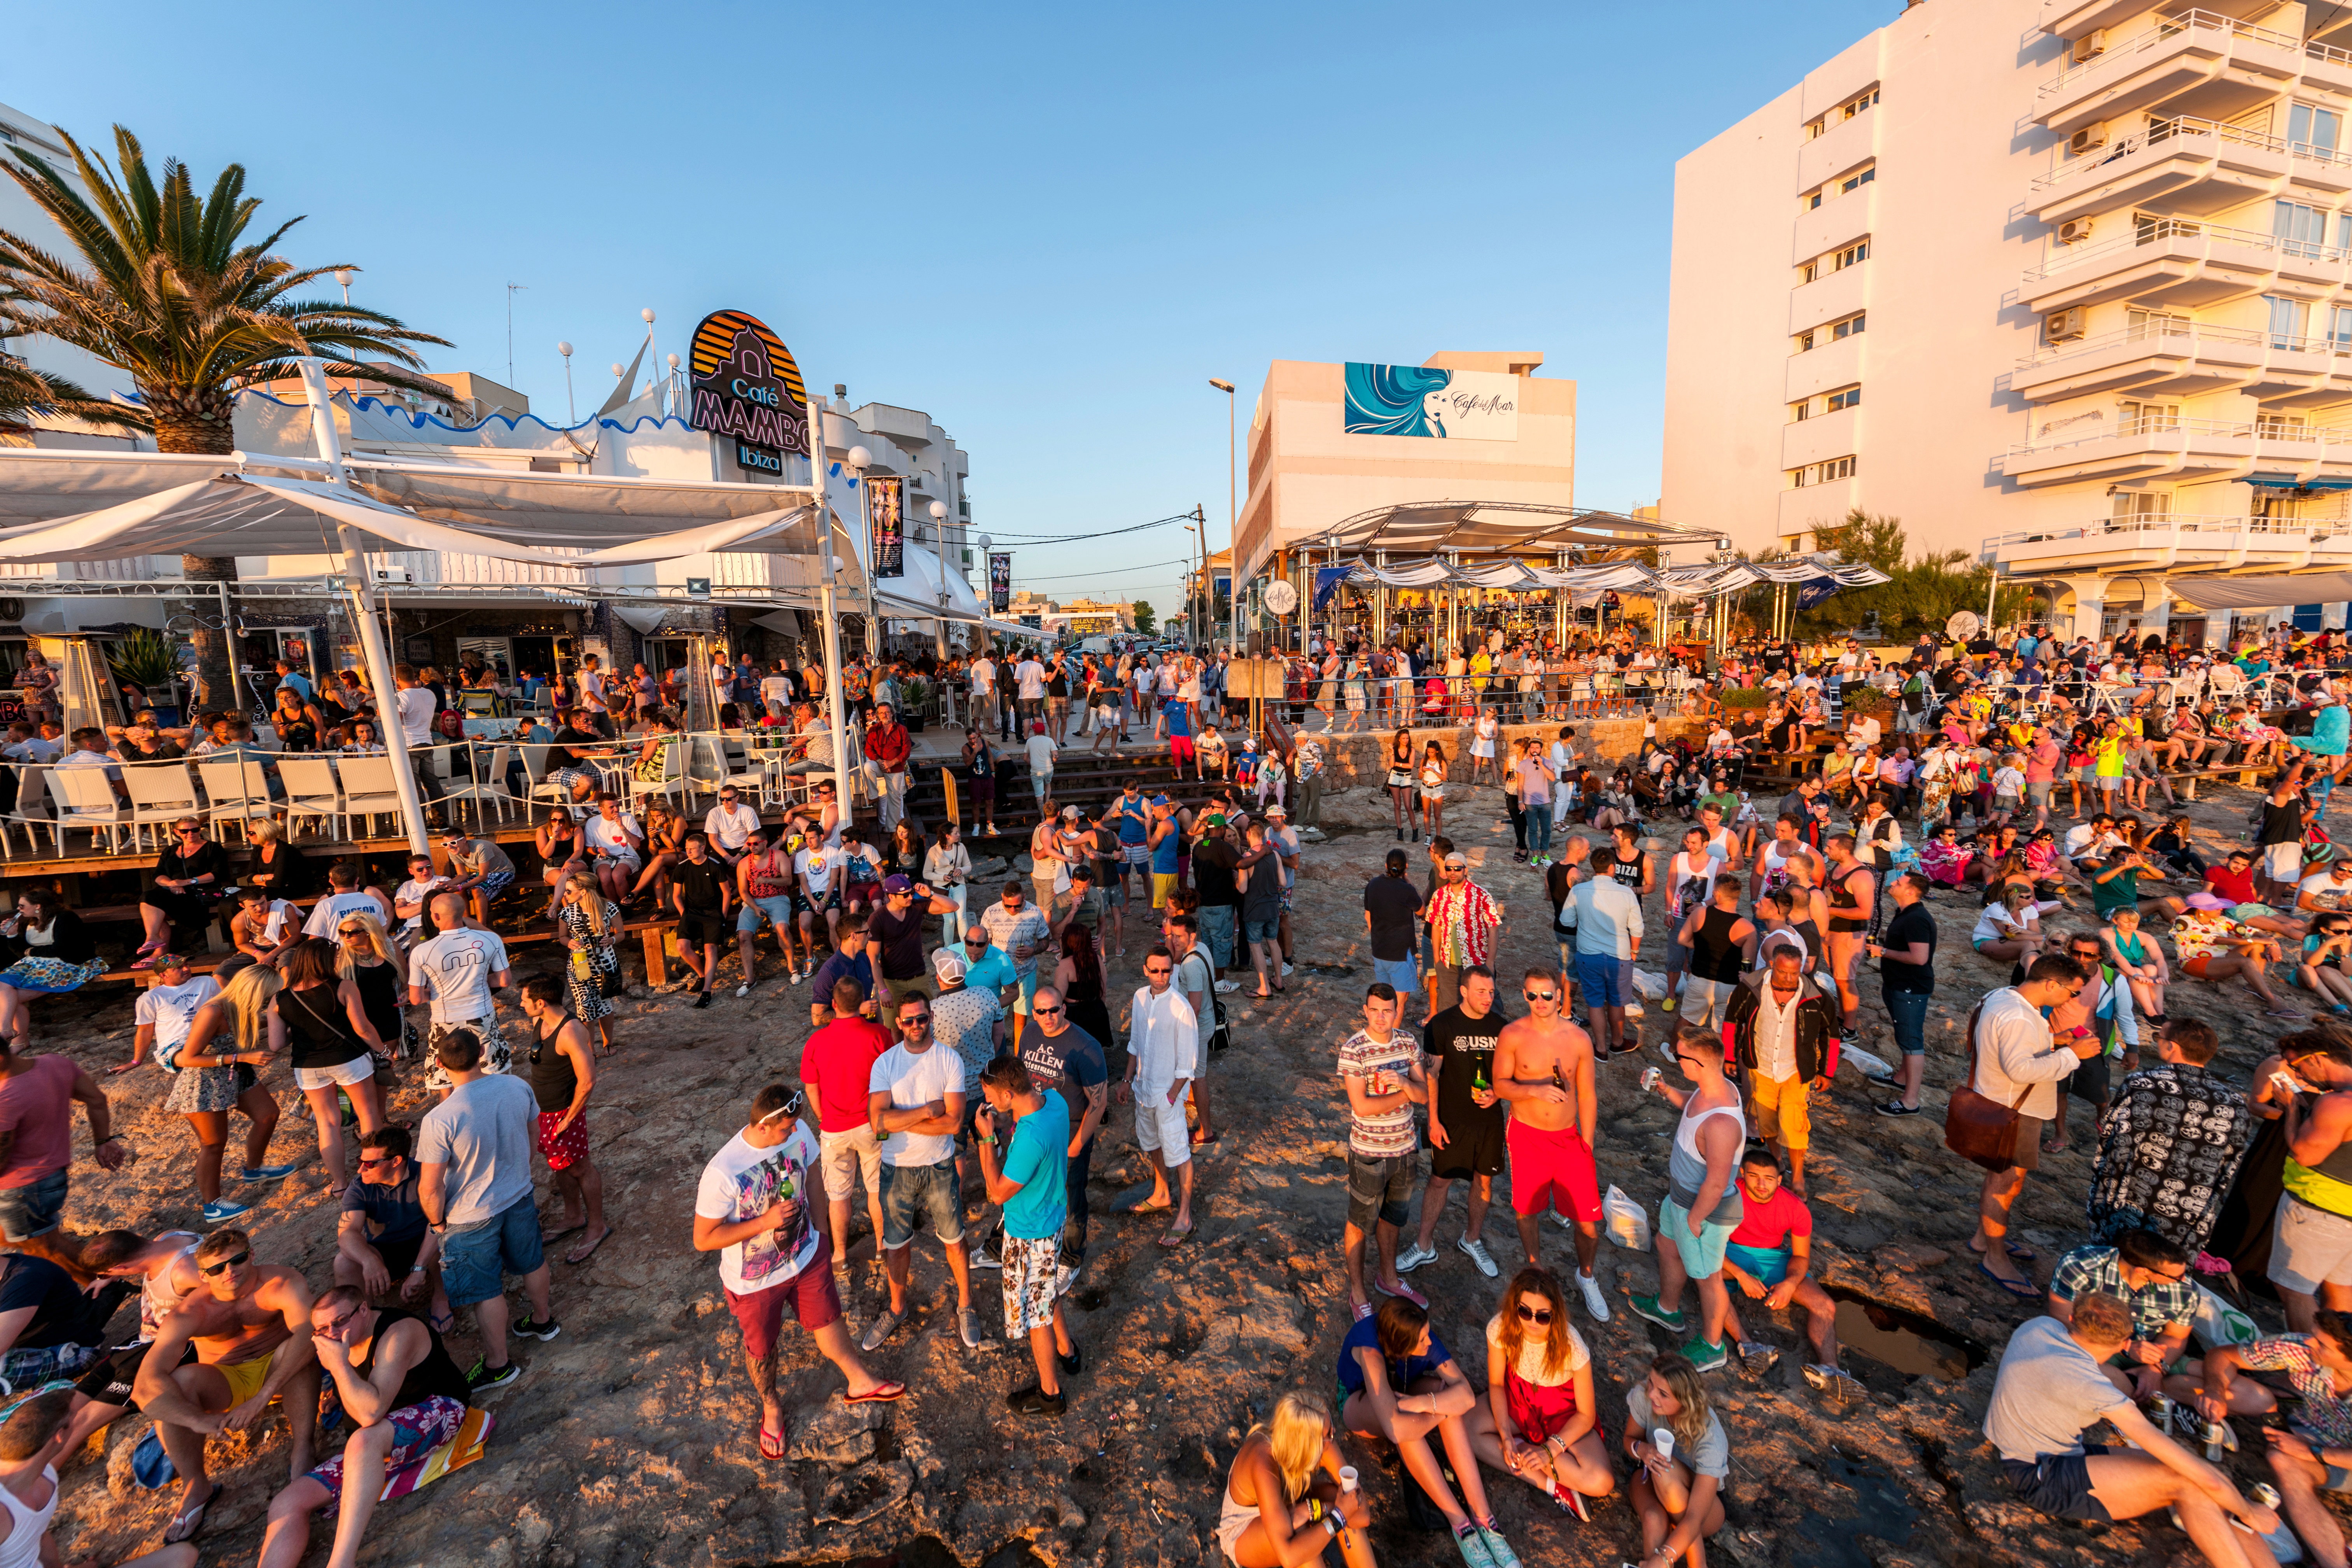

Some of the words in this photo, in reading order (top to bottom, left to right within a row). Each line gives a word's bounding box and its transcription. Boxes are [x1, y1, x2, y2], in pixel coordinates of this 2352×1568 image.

[732, 378, 779, 407] Café
[1451, 391, 1479, 418] Café
[1478, 399, 1489, 408] del
[1482, 394, 1515, 415] Mar
[740, 446, 780, 471] Ibiza
[875, 536, 903, 544] PACHA
[1267, 587, 1283, 606] Café
[1949, 616, 1968, 632] Café
[1037, 1044, 1054, 1055] A.C
[1024, 1050, 1064, 1069] KILLEN
[109, 1381, 132, 1393] BOSS
